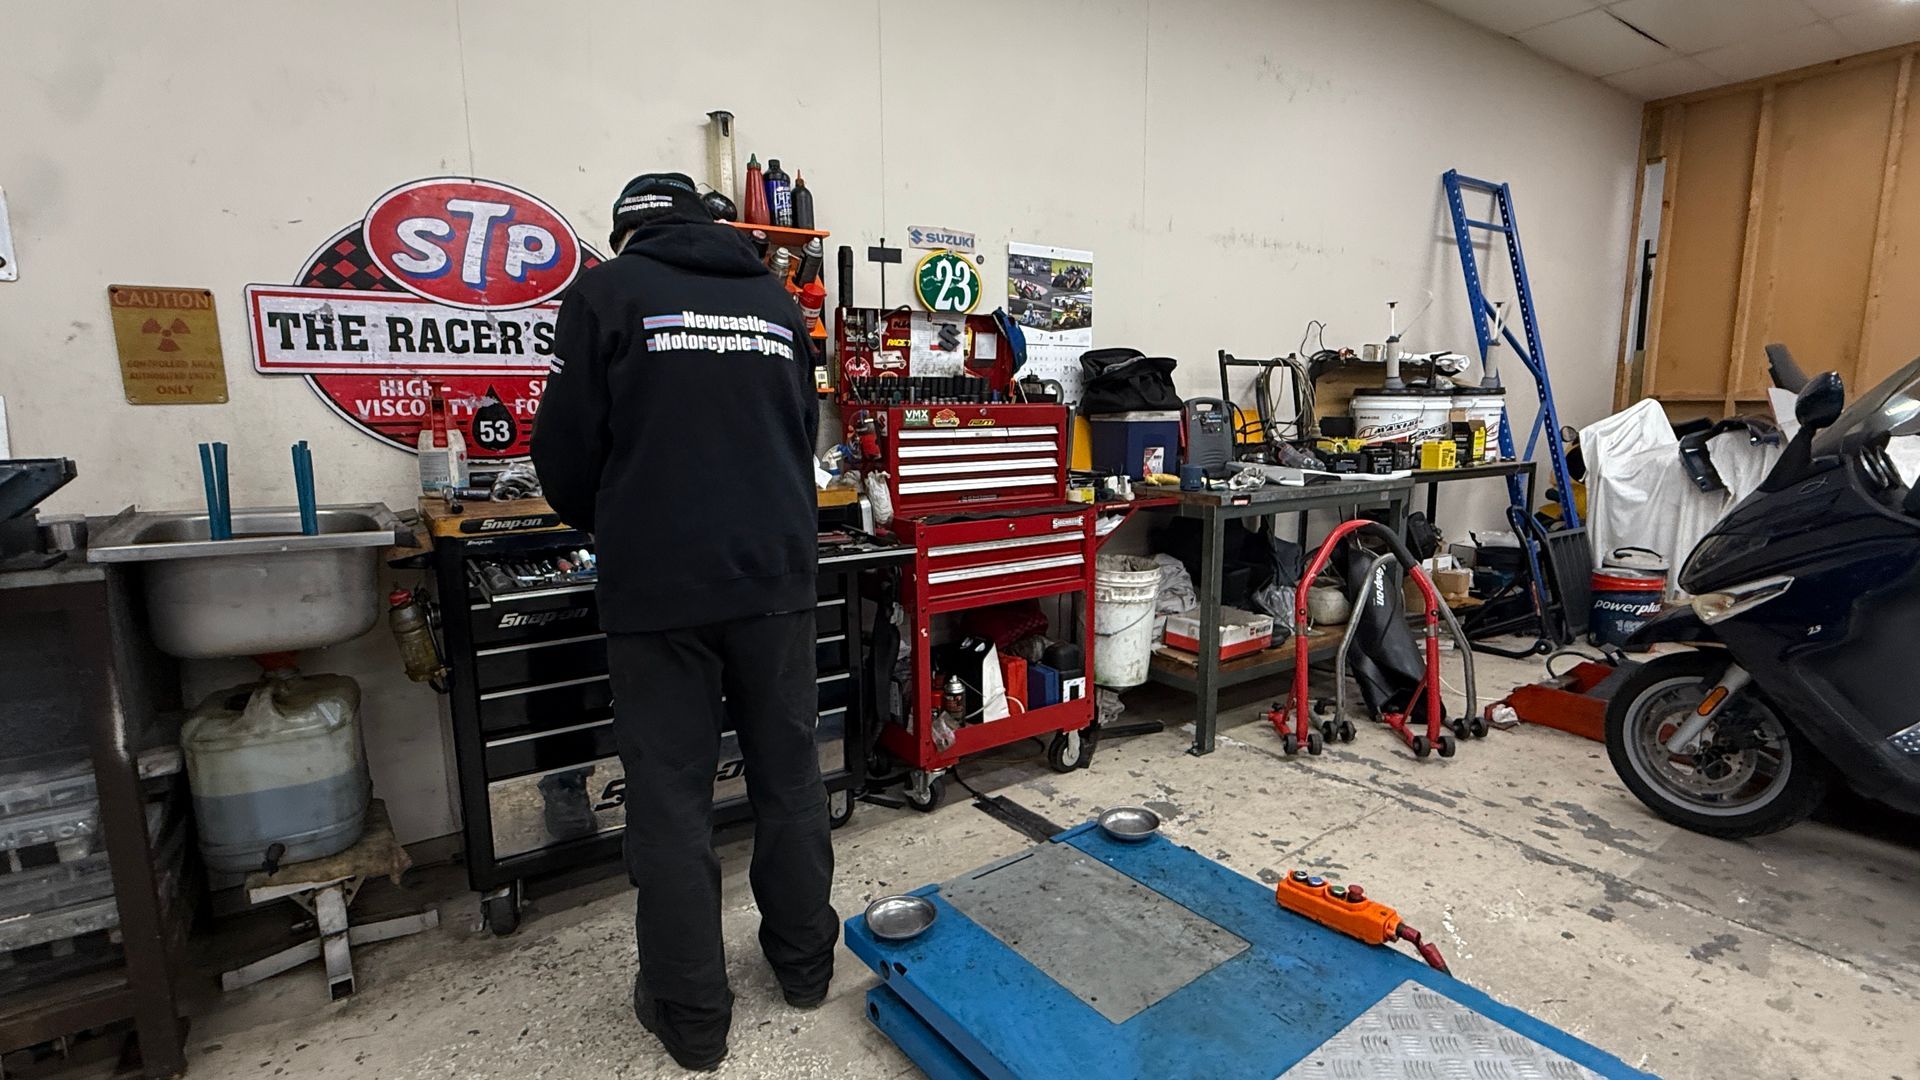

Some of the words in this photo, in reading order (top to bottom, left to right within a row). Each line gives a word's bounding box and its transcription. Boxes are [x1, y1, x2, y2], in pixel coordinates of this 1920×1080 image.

[391, 199, 558, 288] STP
[925, 233, 974, 249] SUZUKI
[935, 258, 971, 312] 23
[113, 290, 210, 308] CAUTION
[682, 310, 768, 333] Newcastle
[267, 312, 369, 352] THE
[385, 315, 555, 356] RACER'S
[654, 331, 751, 354] Motorcycle
[754, 335, 791, 358] Tyres
[156, 385, 194, 395] ONLY
[355, 398, 474, 417] VISCOTY
[905, 409, 929, 420] VMX
[479, 420, 511, 443] 53
[480, 517, 544, 531] Snap-on
[498, 607, 589, 629] Snap-on
